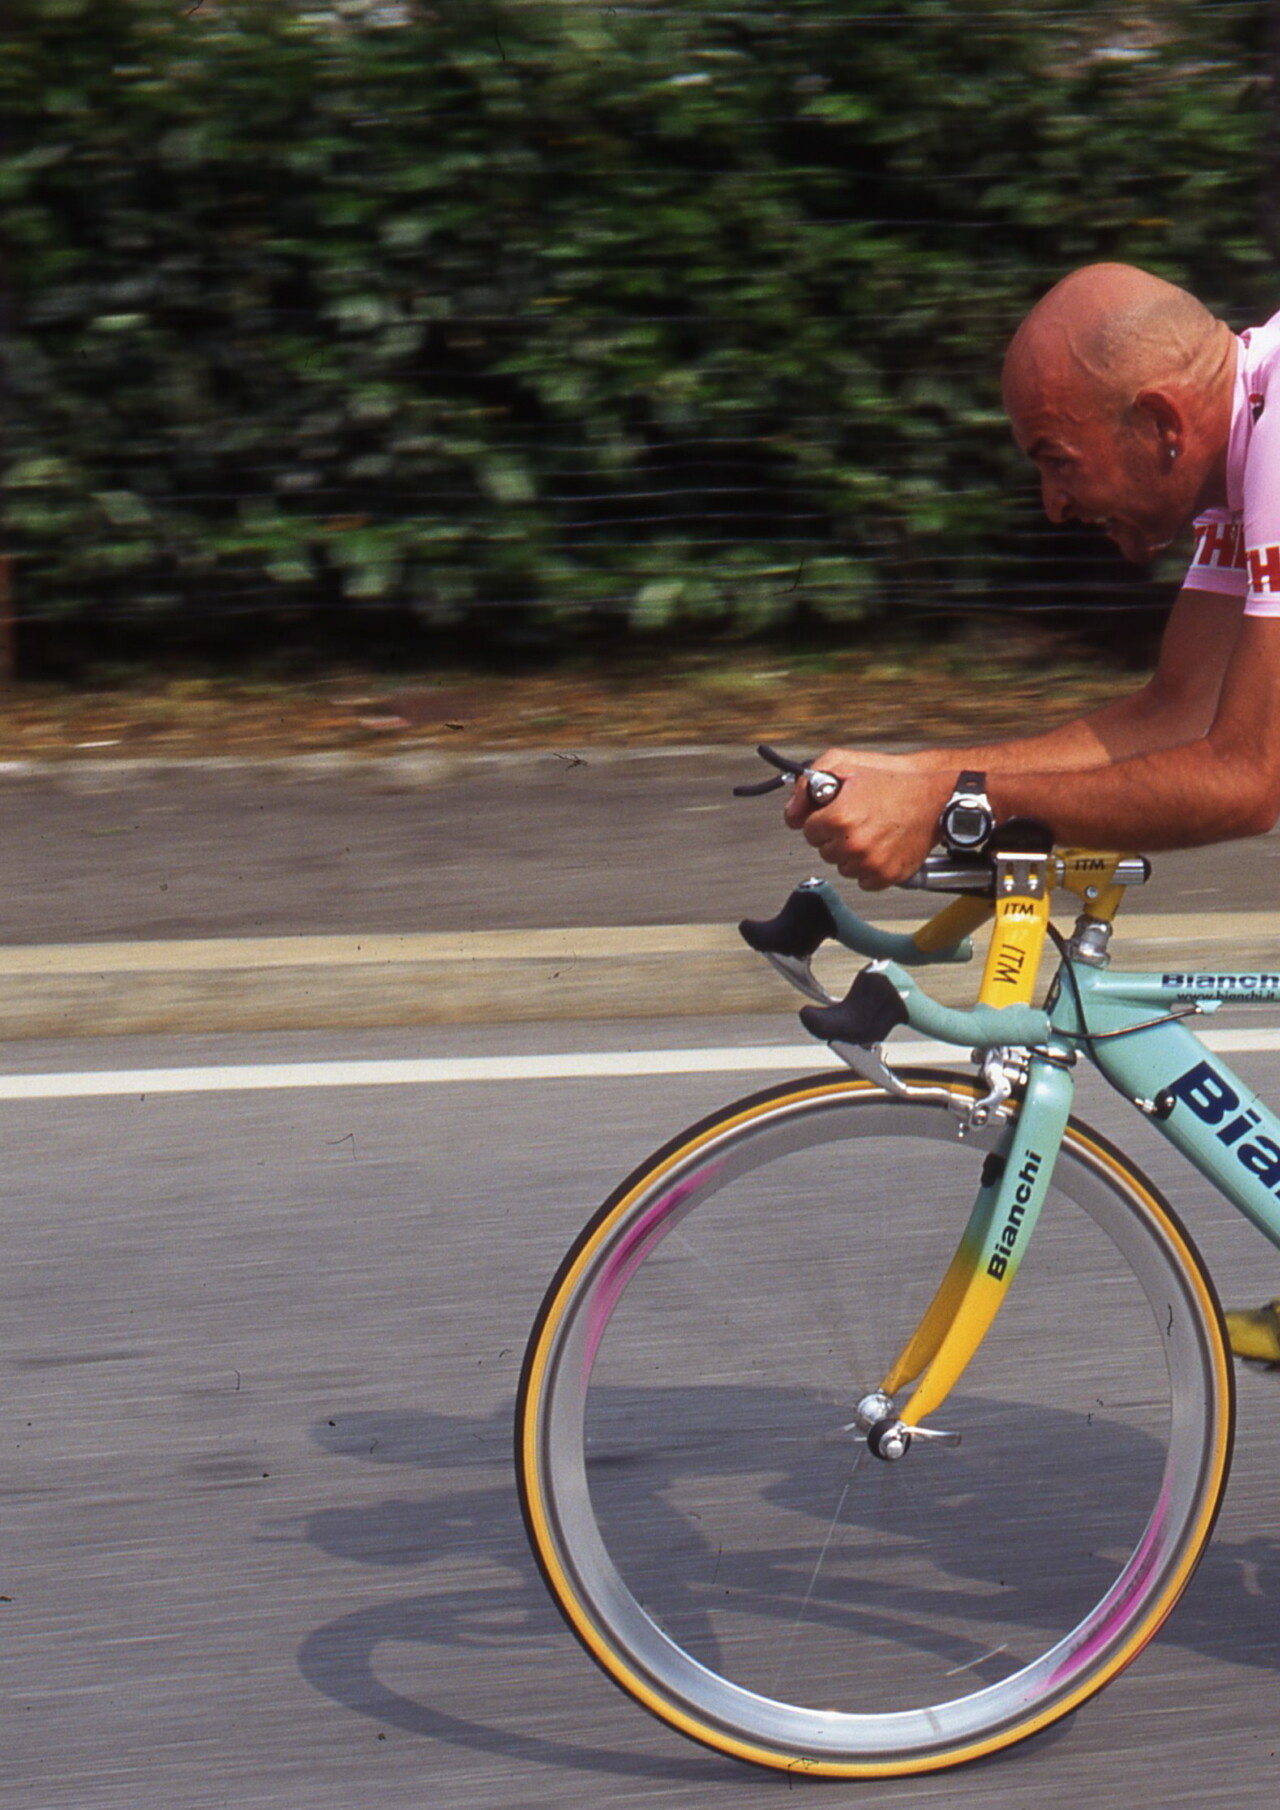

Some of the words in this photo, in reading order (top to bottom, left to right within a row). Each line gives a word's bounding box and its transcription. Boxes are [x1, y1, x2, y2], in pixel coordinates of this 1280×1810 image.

[1074, 858, 1106, 872] ITM
[1003, 902, 1035, 916] ITM
[992, 944, 1026, 986] ITM
[1177, 990, 1276, 1001] www.bianchi.it
[986, 1149, 1043, 1282] Bianchi
